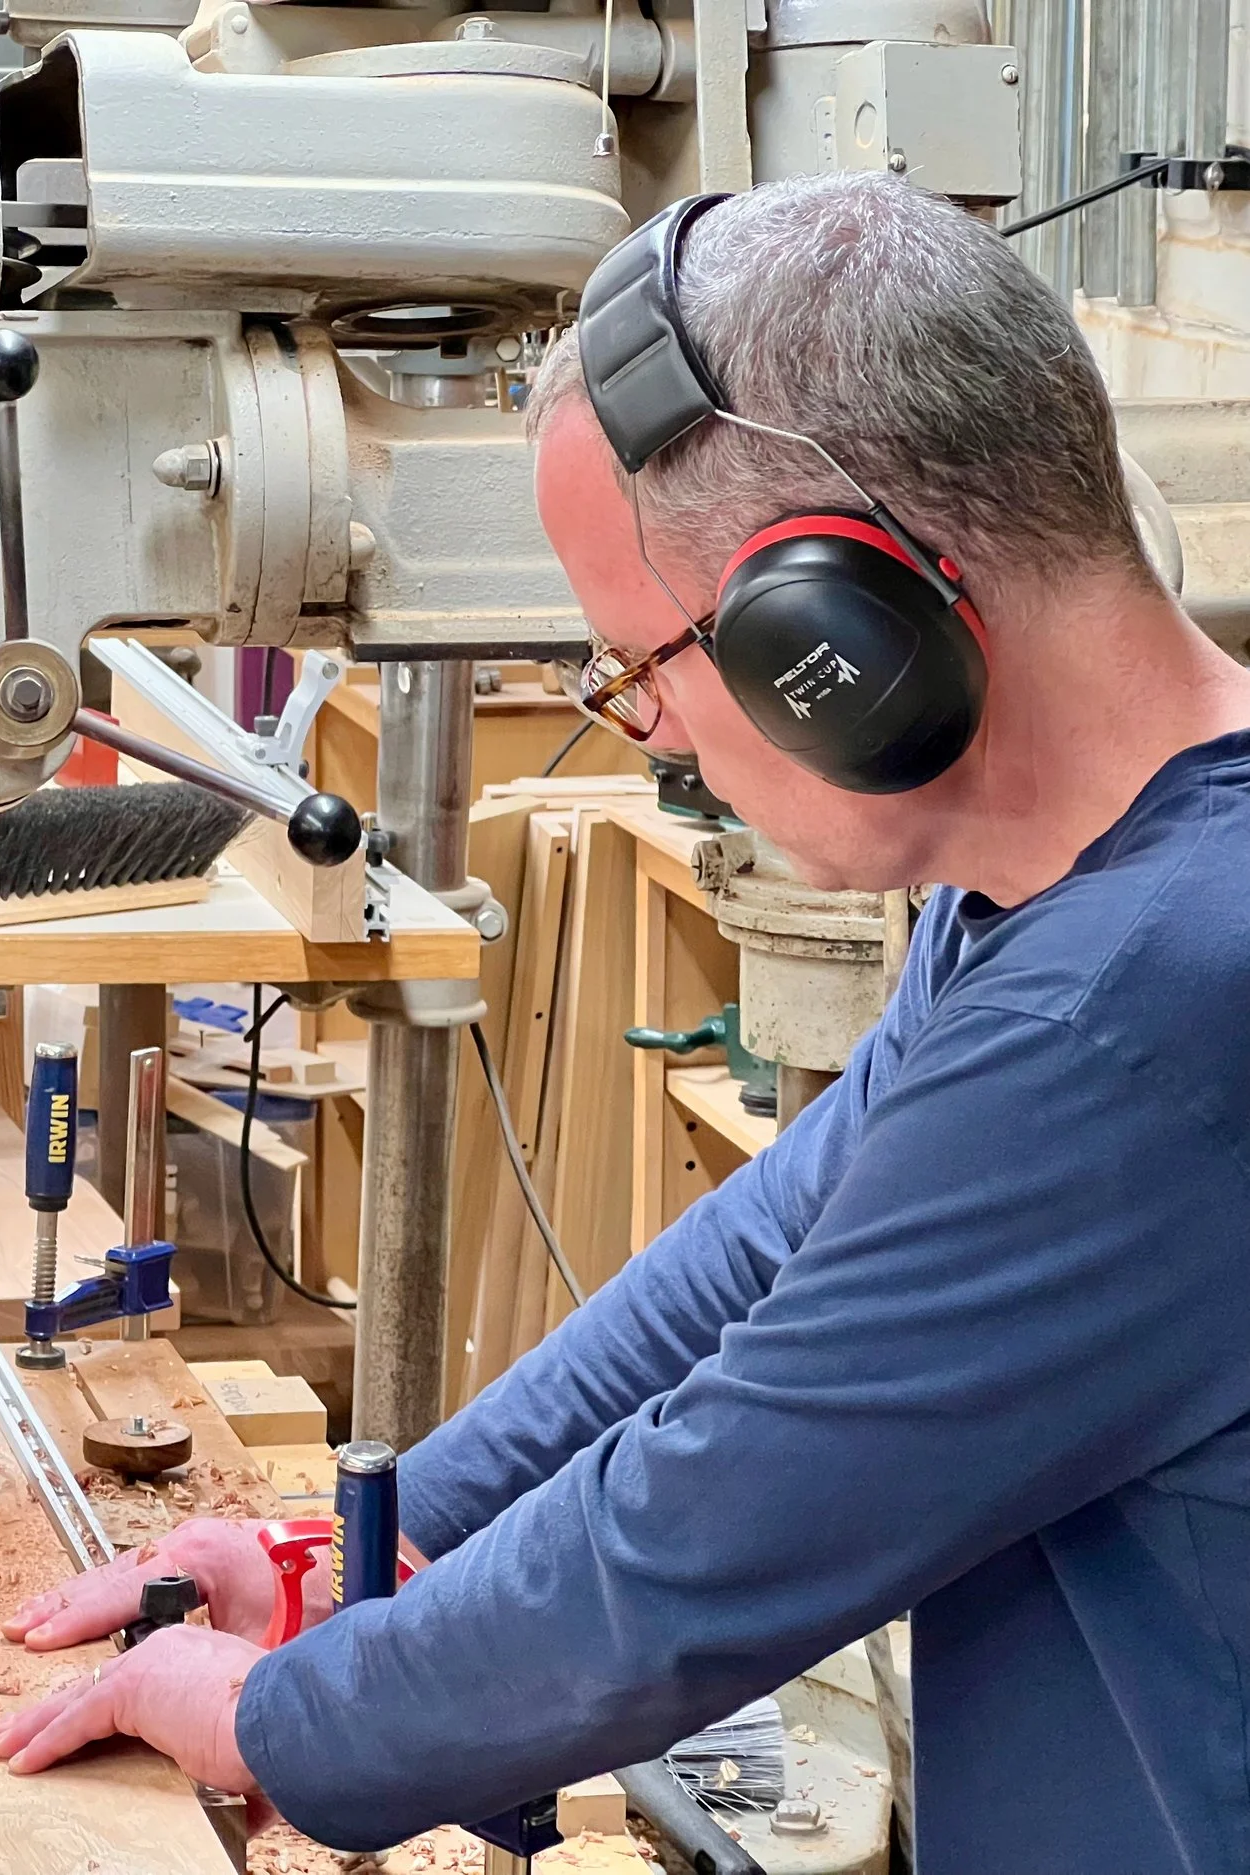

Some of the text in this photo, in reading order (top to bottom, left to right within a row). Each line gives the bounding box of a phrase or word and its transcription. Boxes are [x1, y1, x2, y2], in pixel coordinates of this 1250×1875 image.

[773, 641, 831, 689] PELTOR
[789, 679, 816, 699] TWIN
[817, 660, 837, 679] CUP
[48, 1094, 70, 1163] IRWIN
